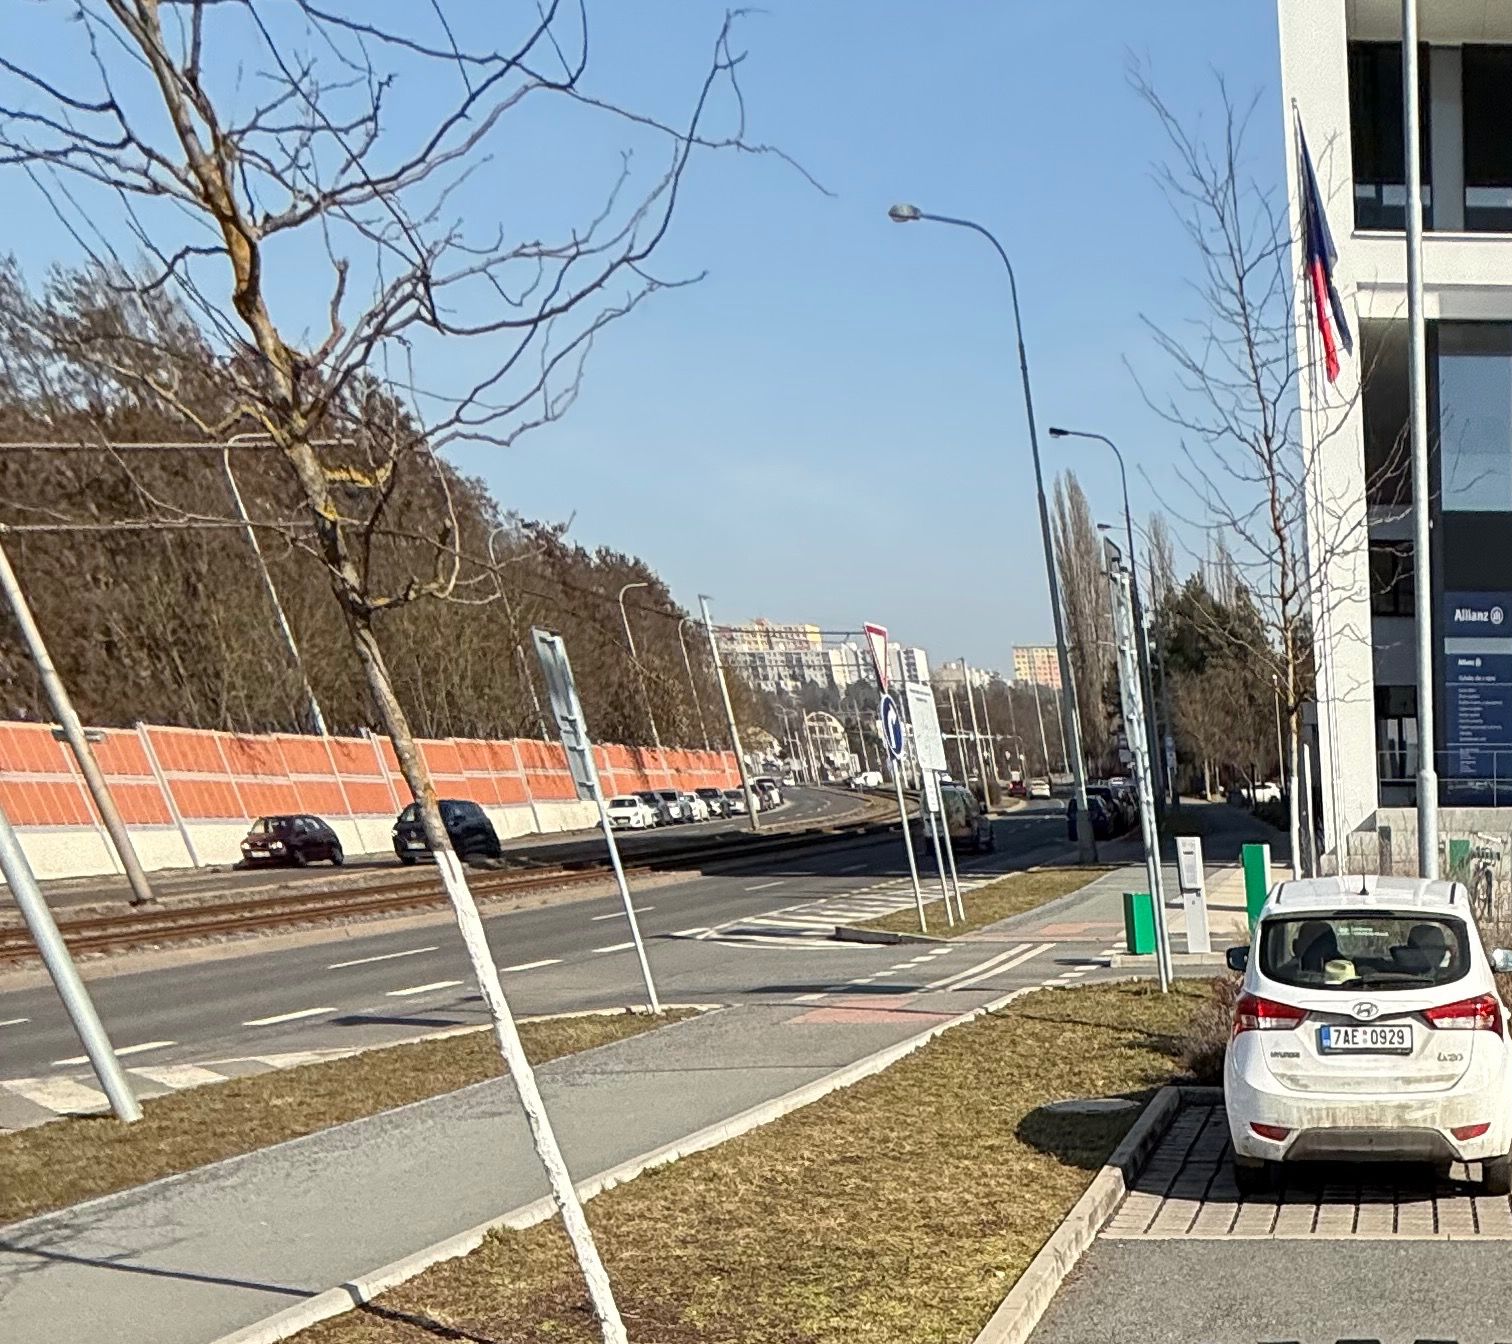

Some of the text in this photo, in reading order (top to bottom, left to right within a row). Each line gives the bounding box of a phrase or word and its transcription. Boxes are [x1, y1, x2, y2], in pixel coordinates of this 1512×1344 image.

[1454, 608, 1489, 621] Allianz
[1333, 1029, 1405, 1045] 7AE 0929
